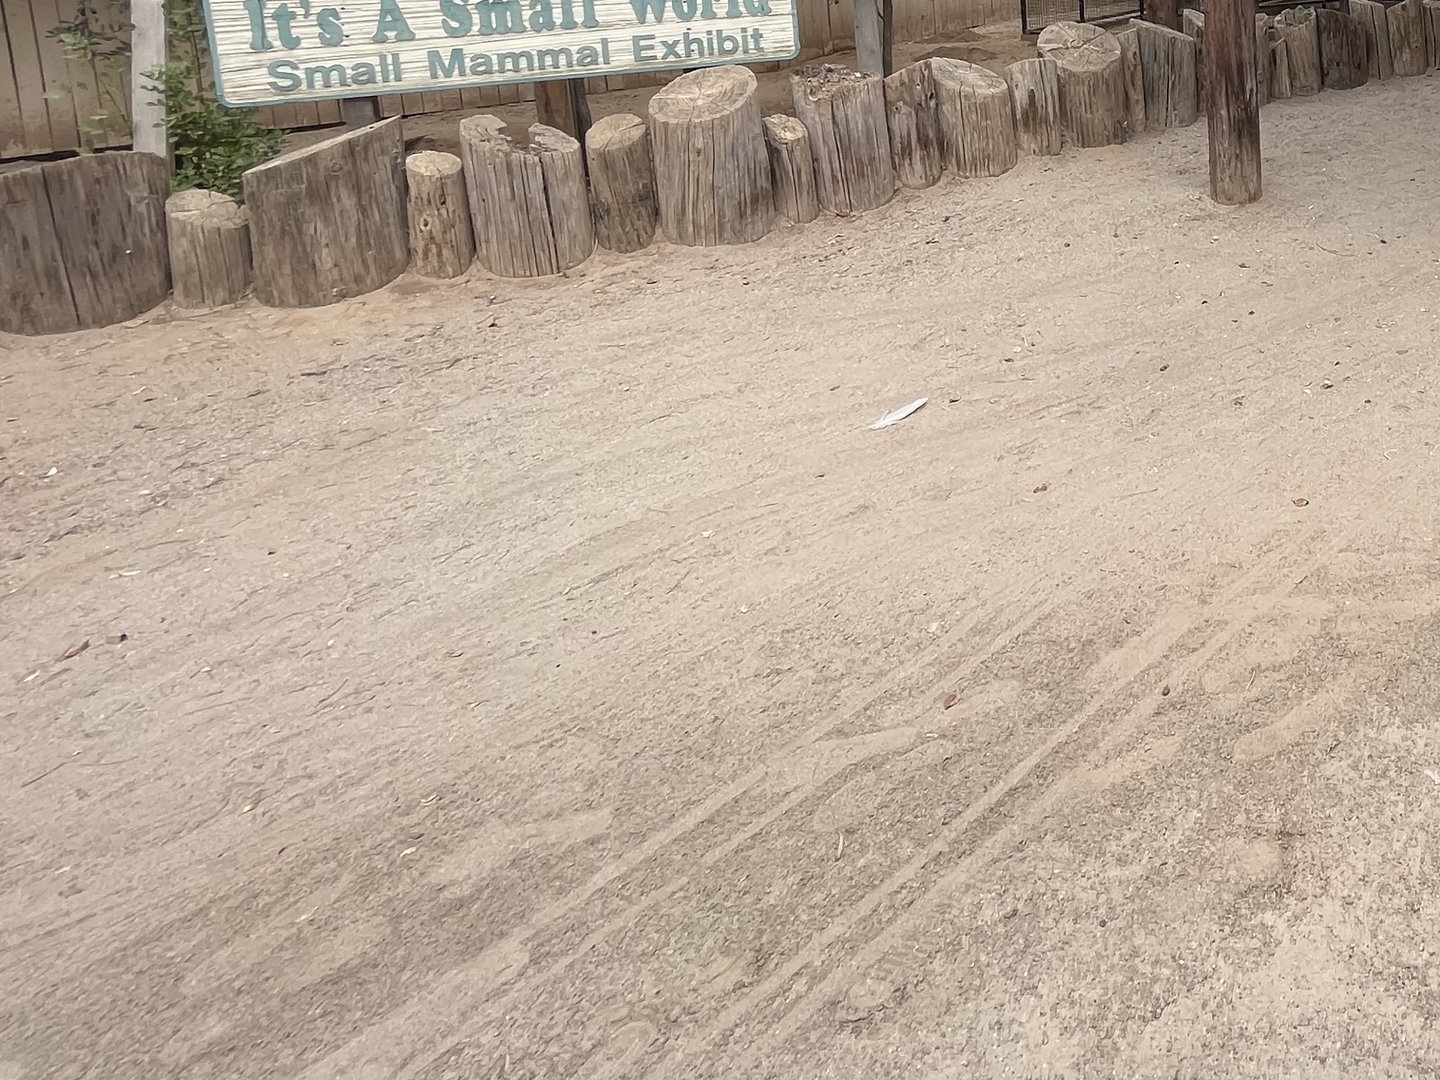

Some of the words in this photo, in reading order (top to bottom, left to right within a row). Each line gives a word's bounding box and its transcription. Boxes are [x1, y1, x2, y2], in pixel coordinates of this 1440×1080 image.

[267, 53, 402, 92] Small
[428, 41, 610, 80] Mammal
[632, 27, 765, 62] Exhibit
